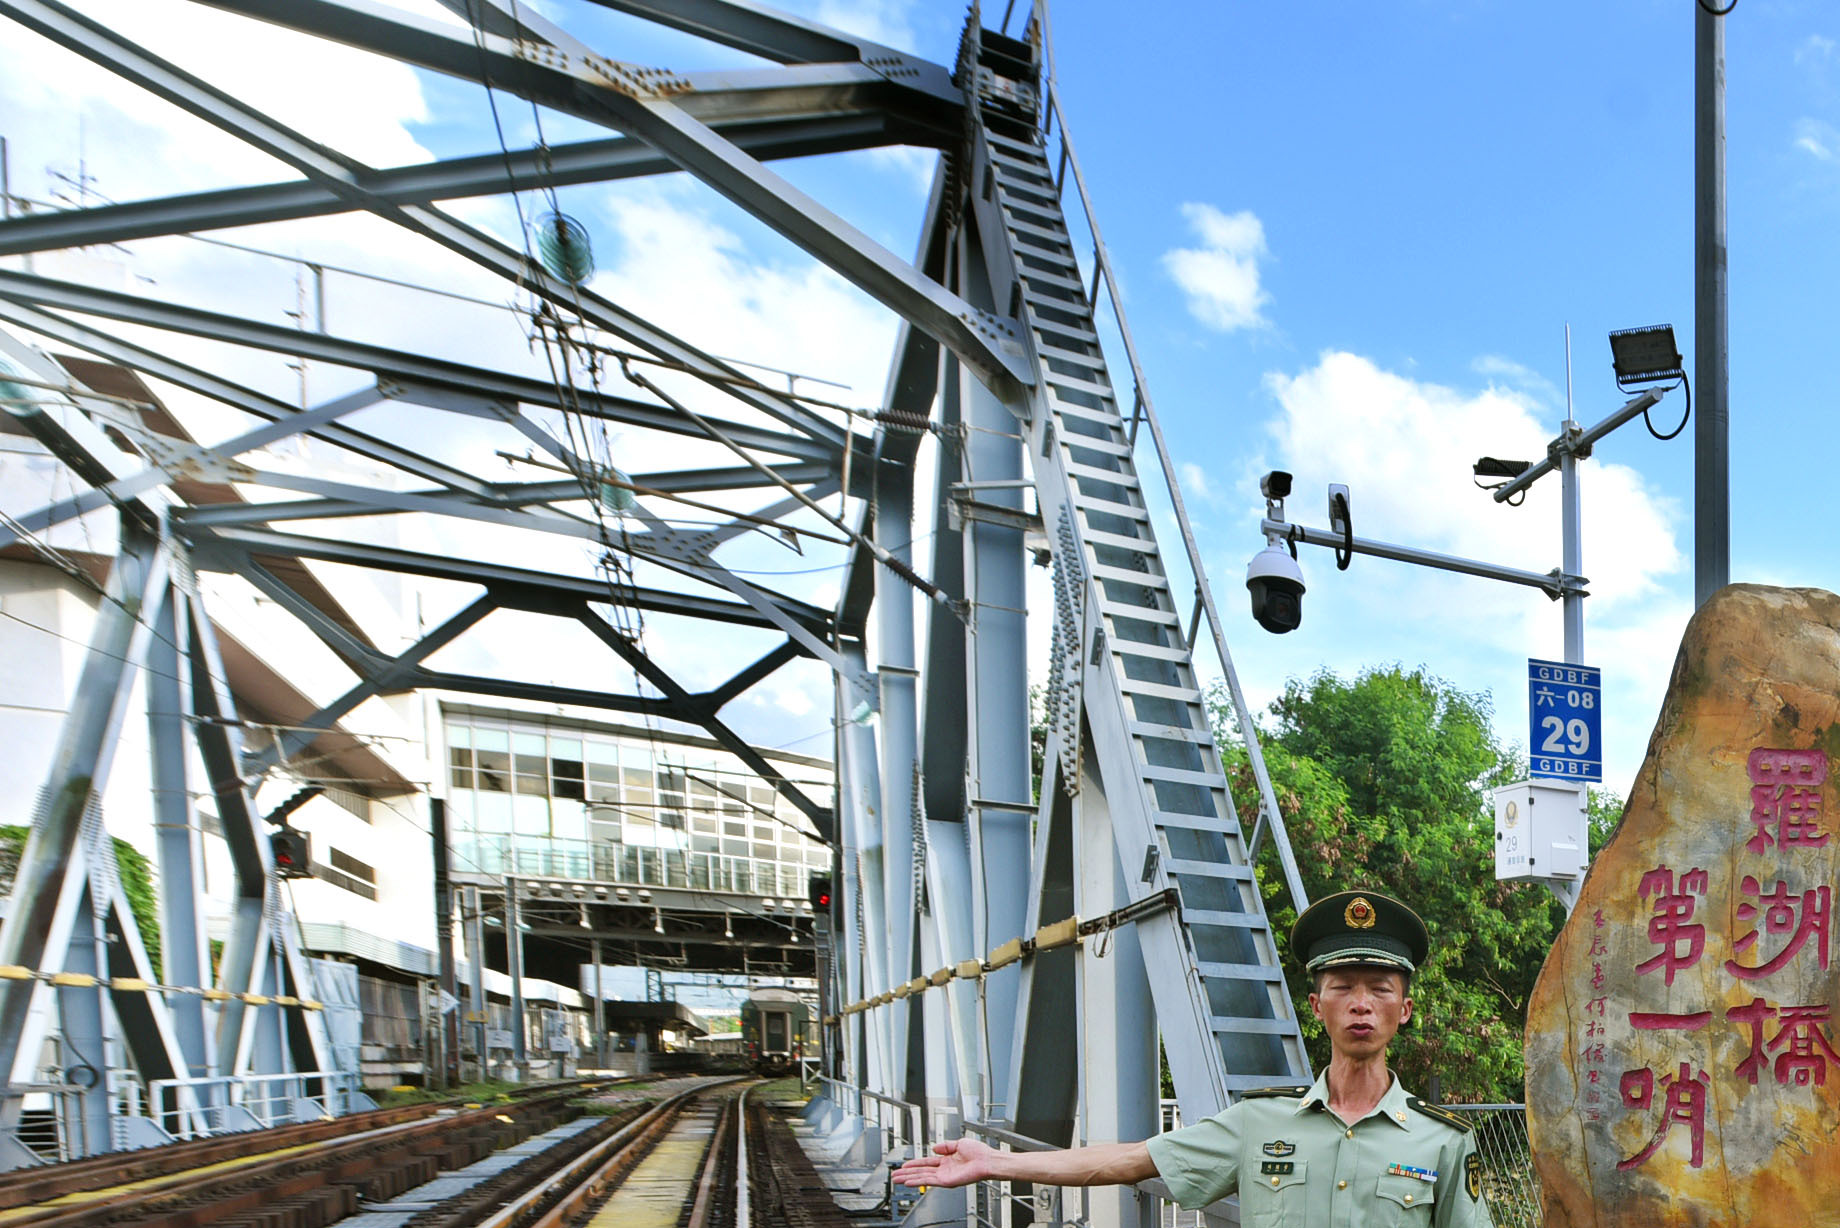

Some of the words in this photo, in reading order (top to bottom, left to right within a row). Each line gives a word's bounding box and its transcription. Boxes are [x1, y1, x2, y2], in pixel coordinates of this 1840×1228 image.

[1538, 667, 1590, 684] GDBF
[1541, 716, 1590, 755] 29
[1539, 759, 1591, 775] GDBF
[1505, 836, 1517, 852] 29
[1616, 864, 1713, 1171] 第一哨
